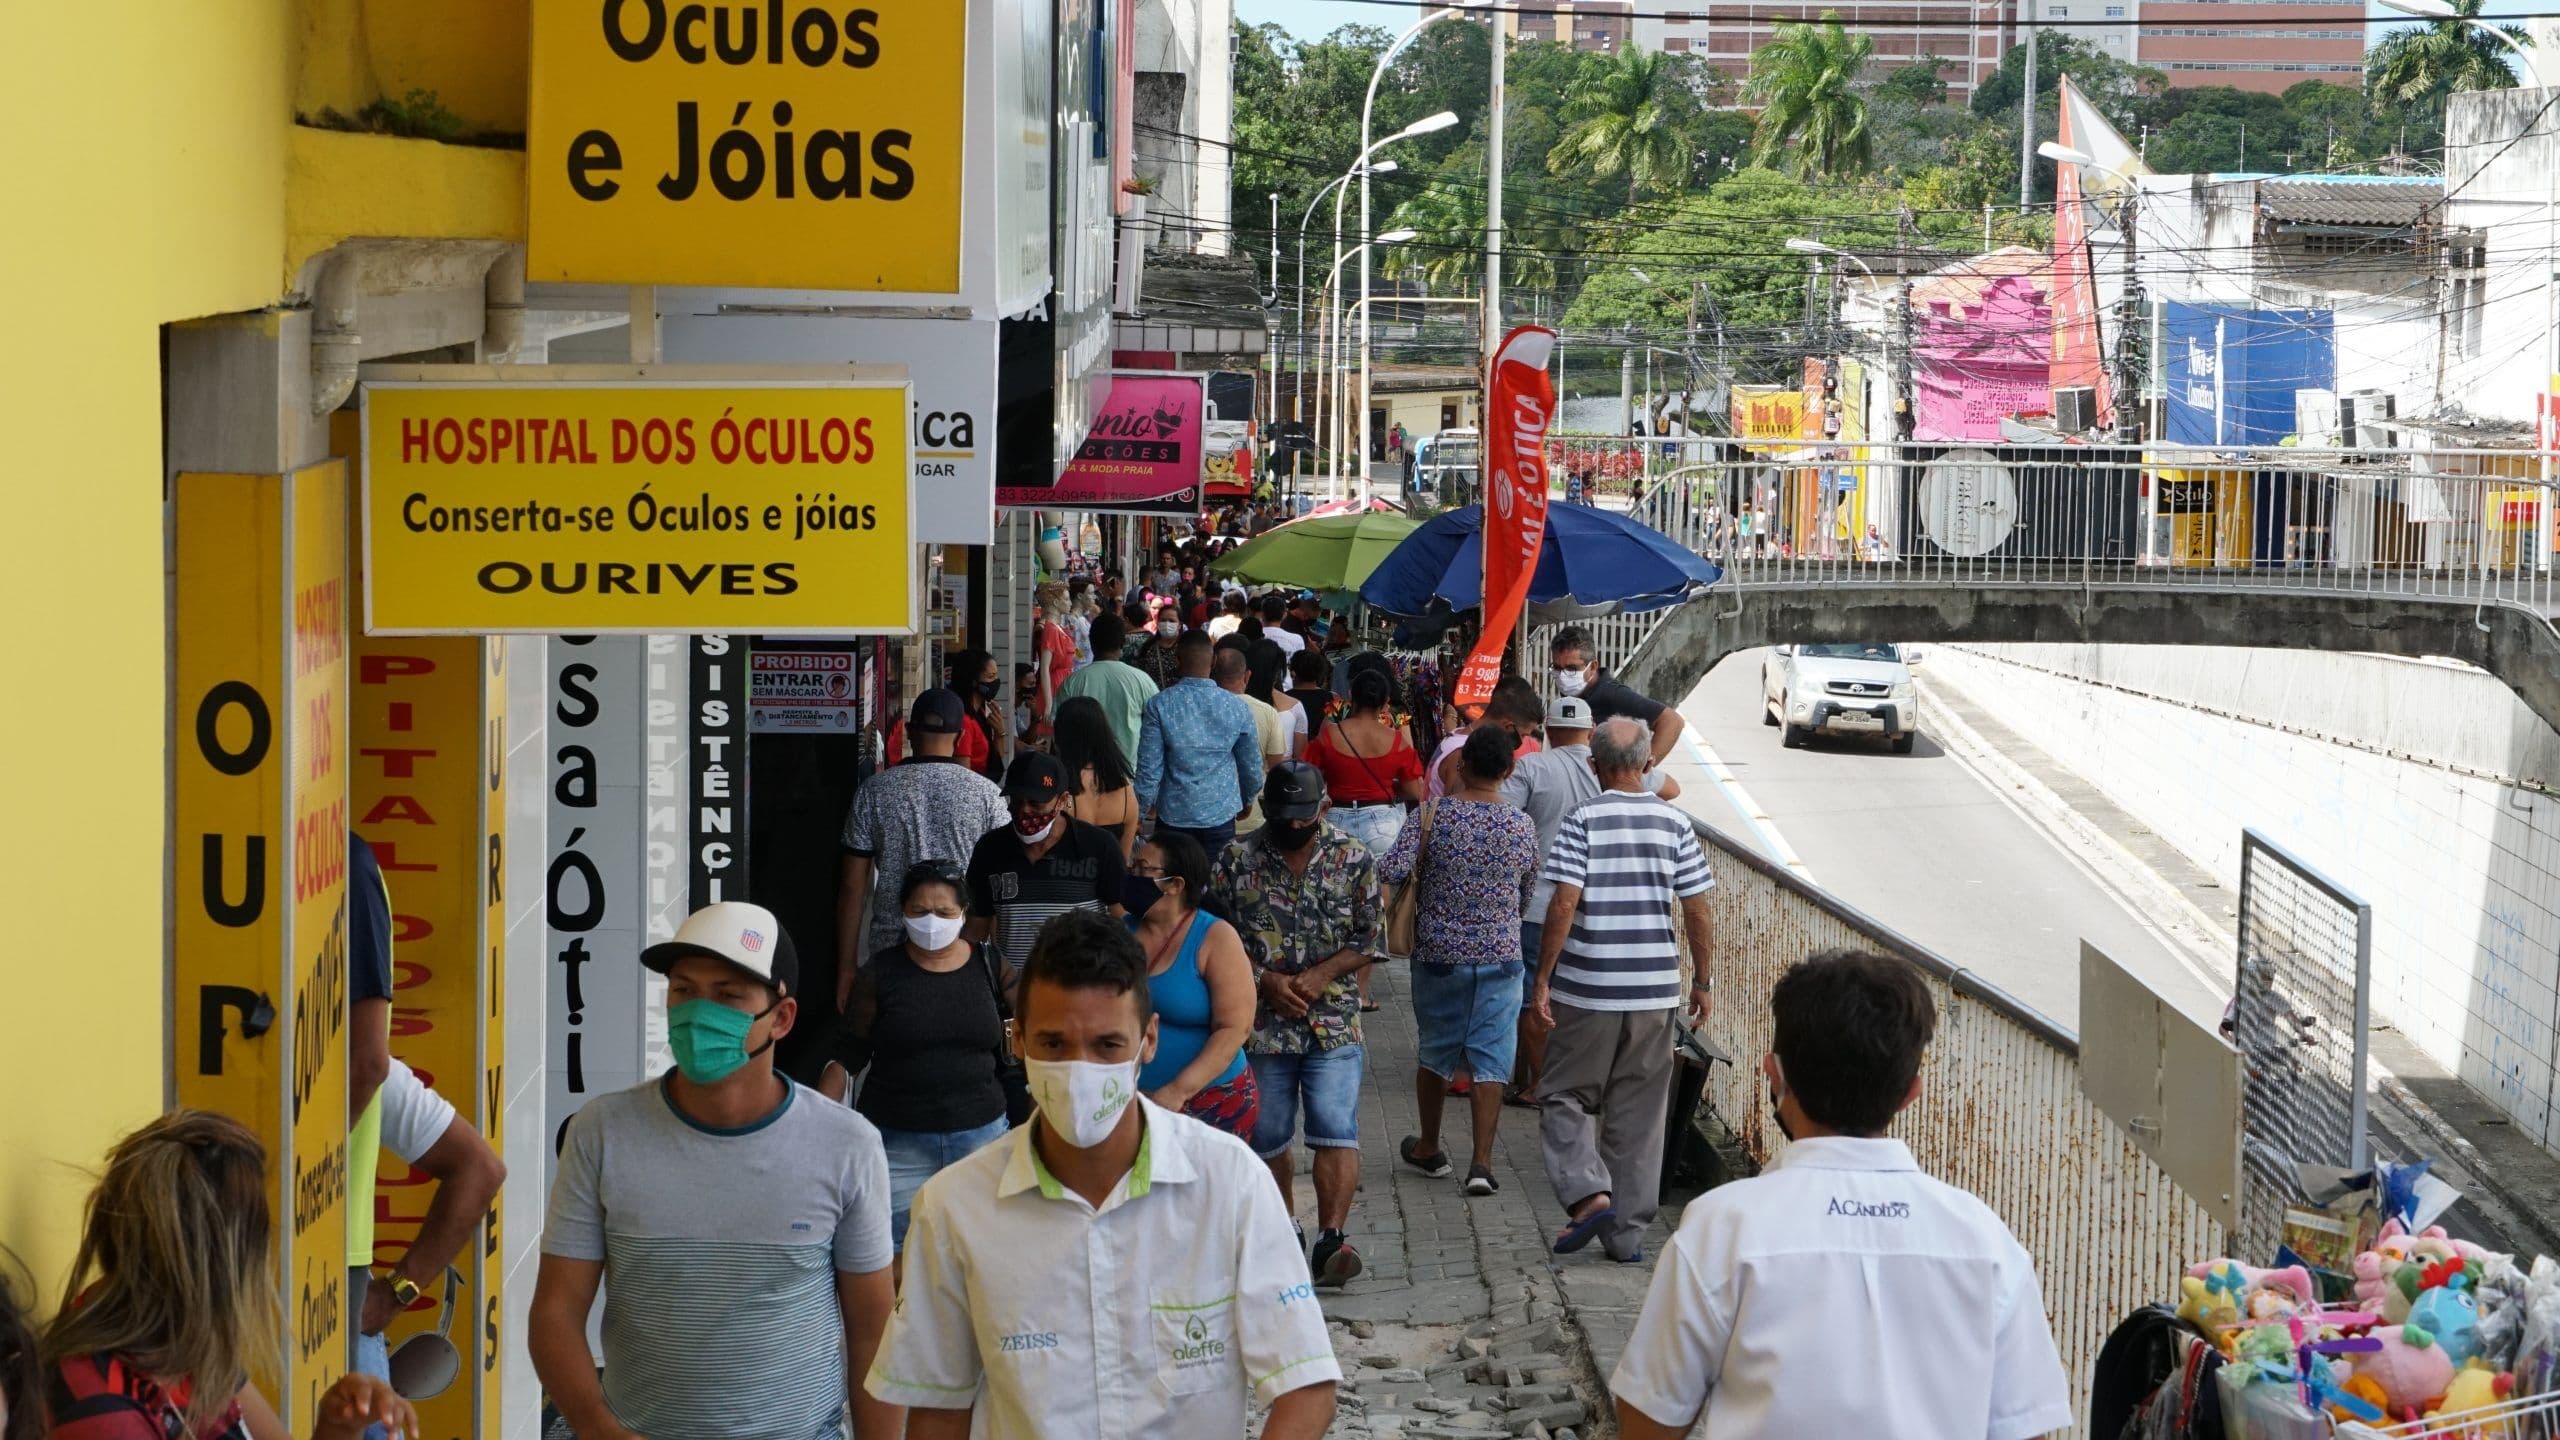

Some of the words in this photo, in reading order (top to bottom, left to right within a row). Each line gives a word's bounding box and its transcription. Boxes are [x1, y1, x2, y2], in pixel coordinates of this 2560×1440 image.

[566, 129, 623, 202] e
[656, 100, 916, 202] Jóias
[401, 416, 598, 465] HOSPITAL
[611, 416, 696, 465] DOS
[710, 406, 875, 465] ÓCULOS
[1089, 464, 1120, 474] MODA
[1122, 465, 1154, 476] PRAIA
[402, 491, 615, 534] Conserta-se
[627, 482, 750, 533] Óculos
[762, 505, 783, 533] e
[792, 493, 877, 541] jóias
[476, 560, 800, 596] OURIVES
[753, 655, 848, 669] PROIBIDO
[752, 673, 824, 687] ENTRAR
[752, 687, 775, 697] SEM
[775, 686, 826, 697] MÁSCARA
[300, 1256, 338, 1364] Óculos
[999, 1332, 1059, 1352] ZEISS
